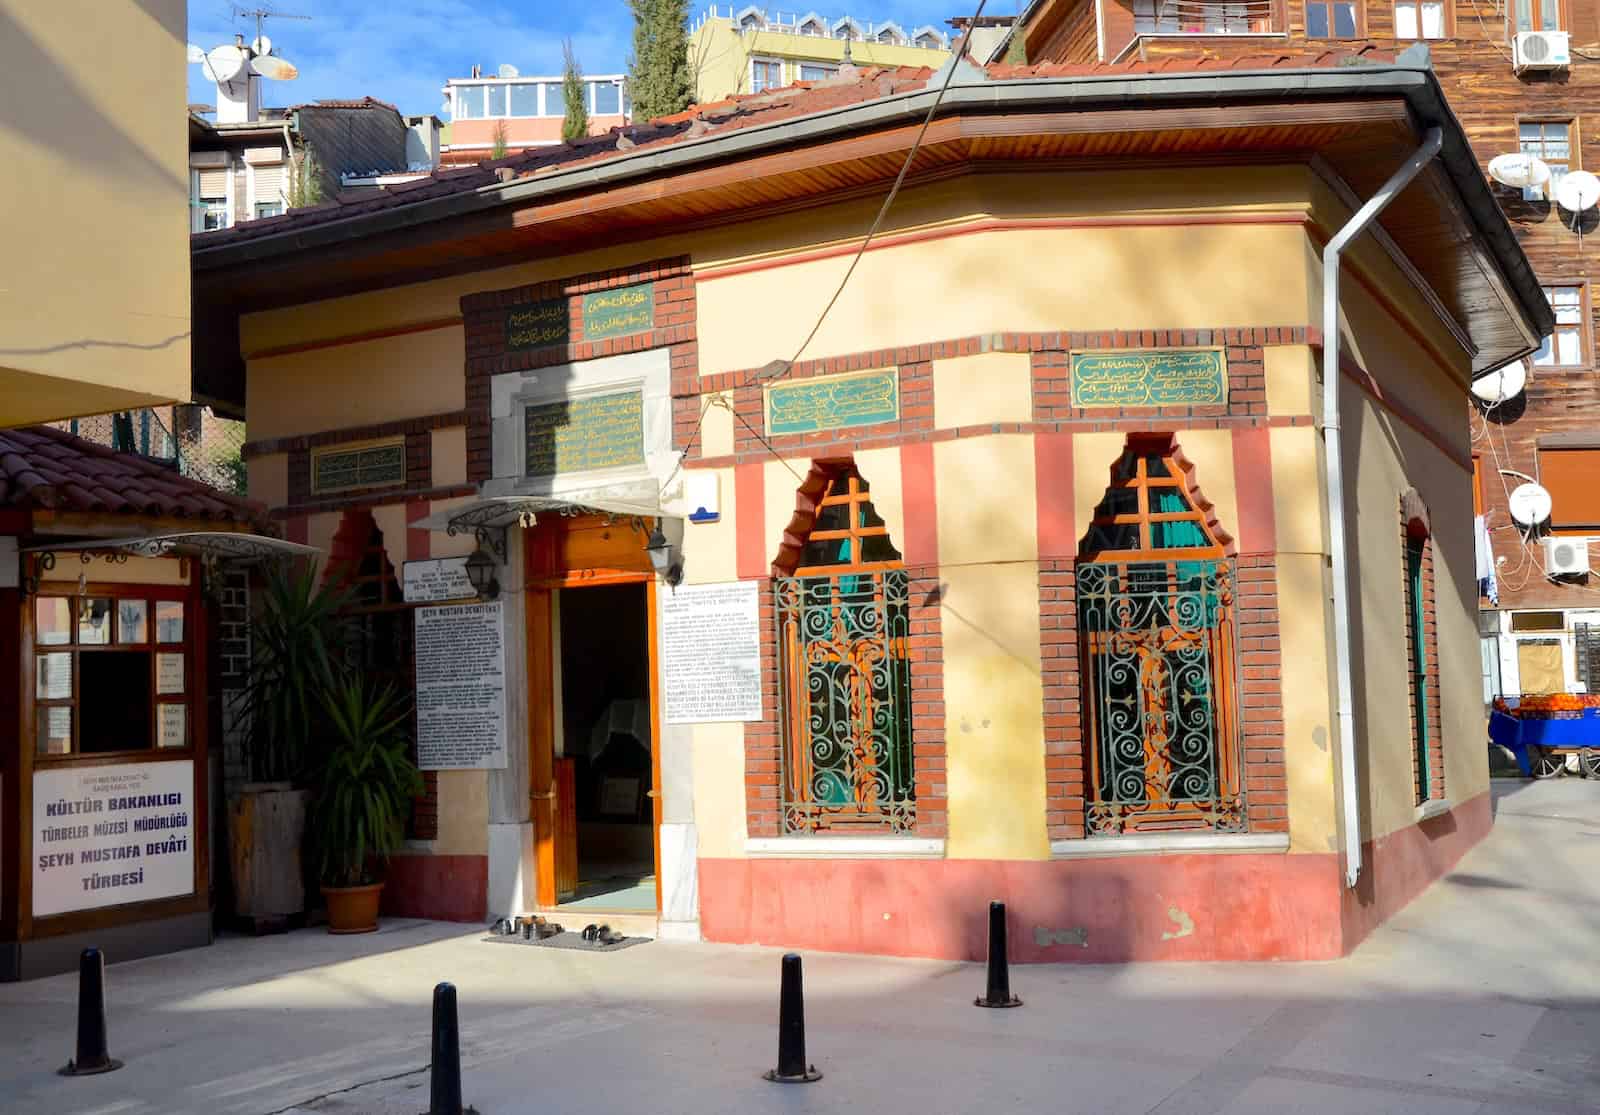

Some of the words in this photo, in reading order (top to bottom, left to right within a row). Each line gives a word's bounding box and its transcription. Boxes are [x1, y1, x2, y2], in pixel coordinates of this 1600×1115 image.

[46, 797, 103, 817] KÜLTÜR
[42, 825, 89, 843] TÜRBELER
[94, 819, 128, 837] MÜZESİ
[134, 812, 188, 833] MÜDÜRLÜĞÜ
[39, 852, 74, 872] ŞEYH
[81, 845, 141, 864] MUSTAFA
[146, 834, 188, 856] DEVÂTİ
[82, 867, 144, 891] TÜRBESİ
